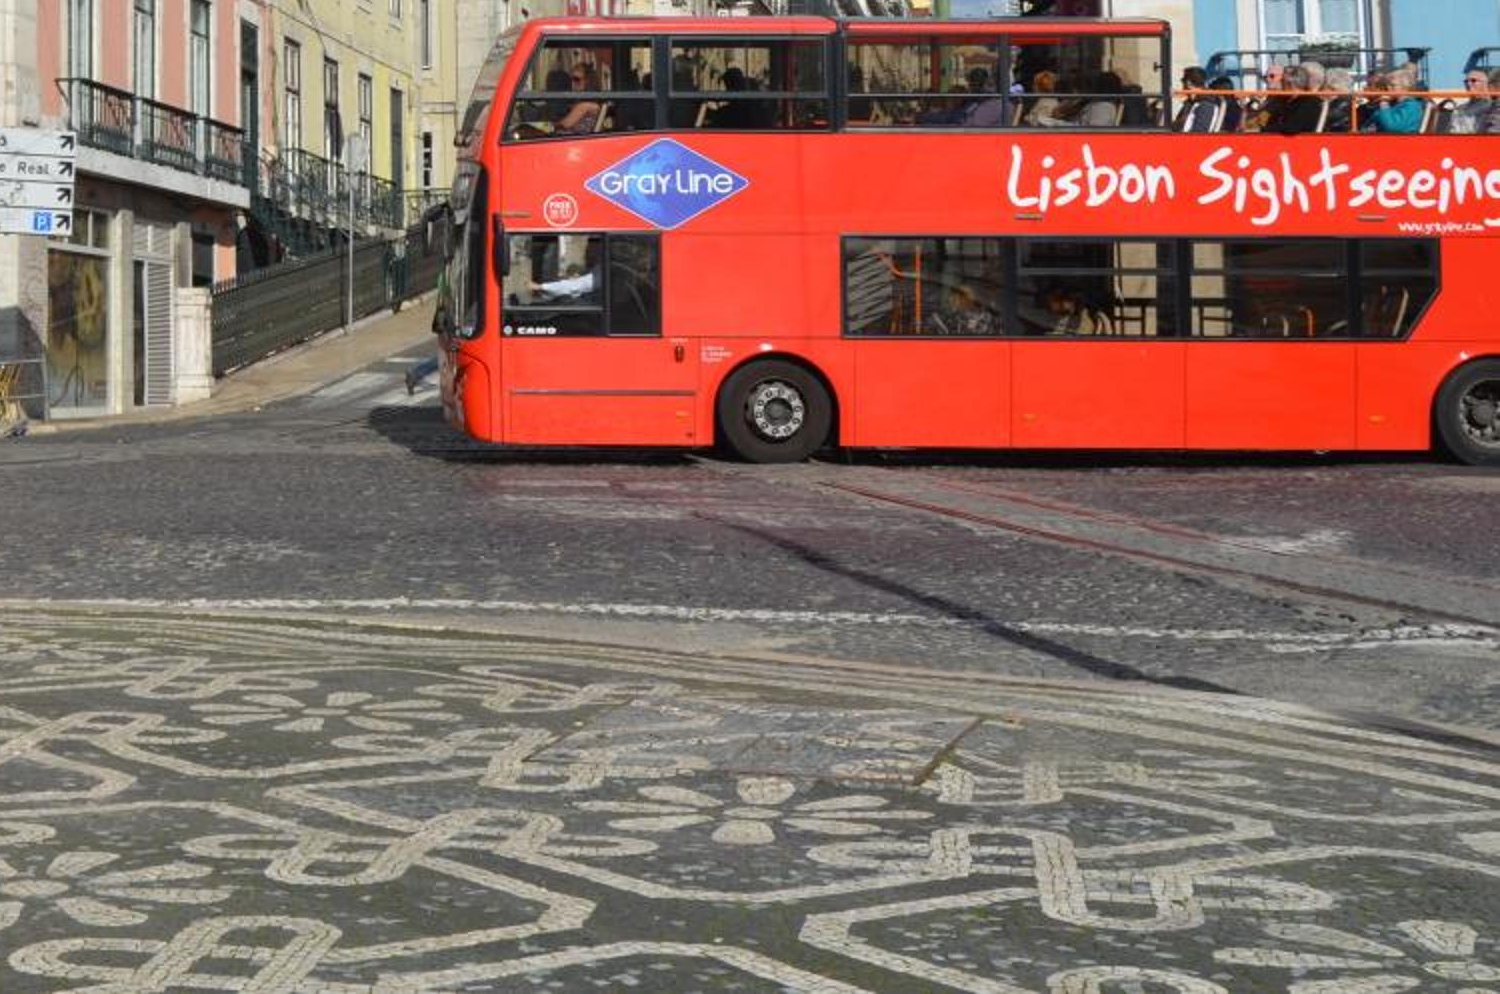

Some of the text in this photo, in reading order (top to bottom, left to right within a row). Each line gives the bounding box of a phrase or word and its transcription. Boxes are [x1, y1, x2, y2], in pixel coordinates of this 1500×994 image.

[17, 161, 49, 175] Real
[601, 169, 733, 194] Gray Line
[1007, 144, 1175, 213] Lisbon
[517, 327, 557, 335] CAMO
